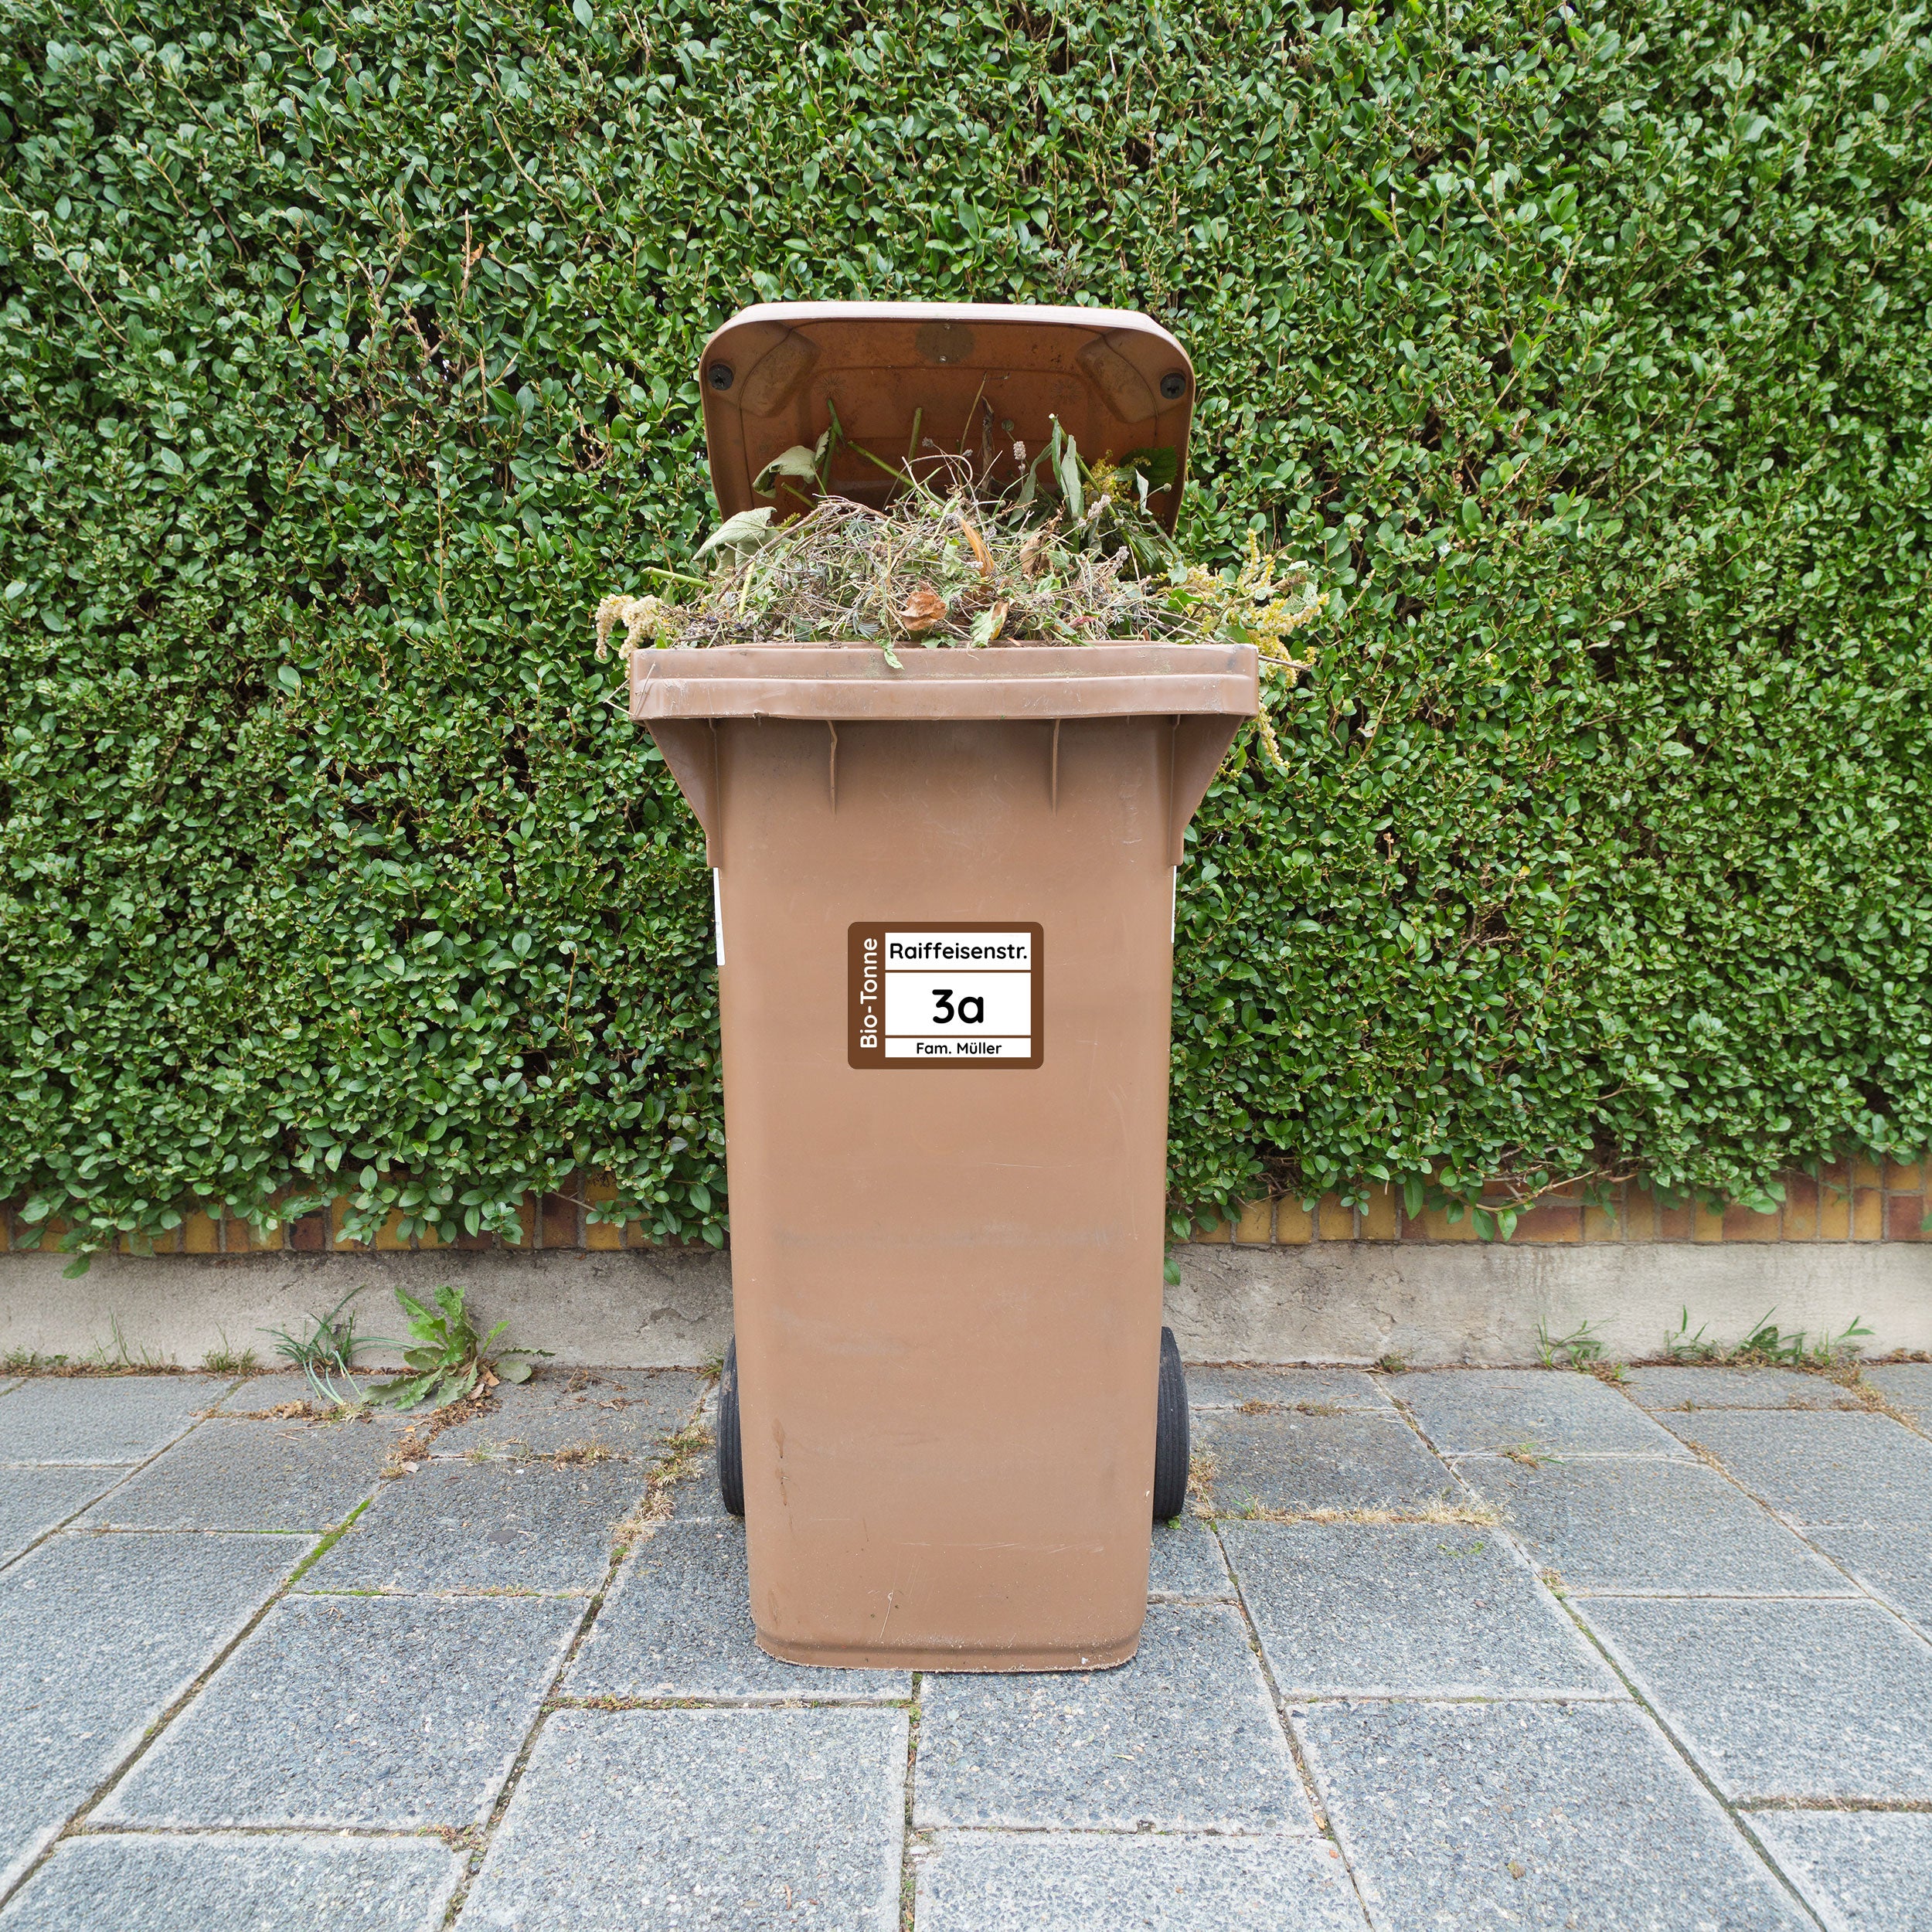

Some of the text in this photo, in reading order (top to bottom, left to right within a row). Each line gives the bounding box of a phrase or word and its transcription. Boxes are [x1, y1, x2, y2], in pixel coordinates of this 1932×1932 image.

[889, 942, 1028, 960] Raiffeisenstr.
[859, 937, 878, 1048] Bio-Tonne
[931, 988, 984, 1024] 3a
[916, 1042, 1002, 1055] Fam. Müller
